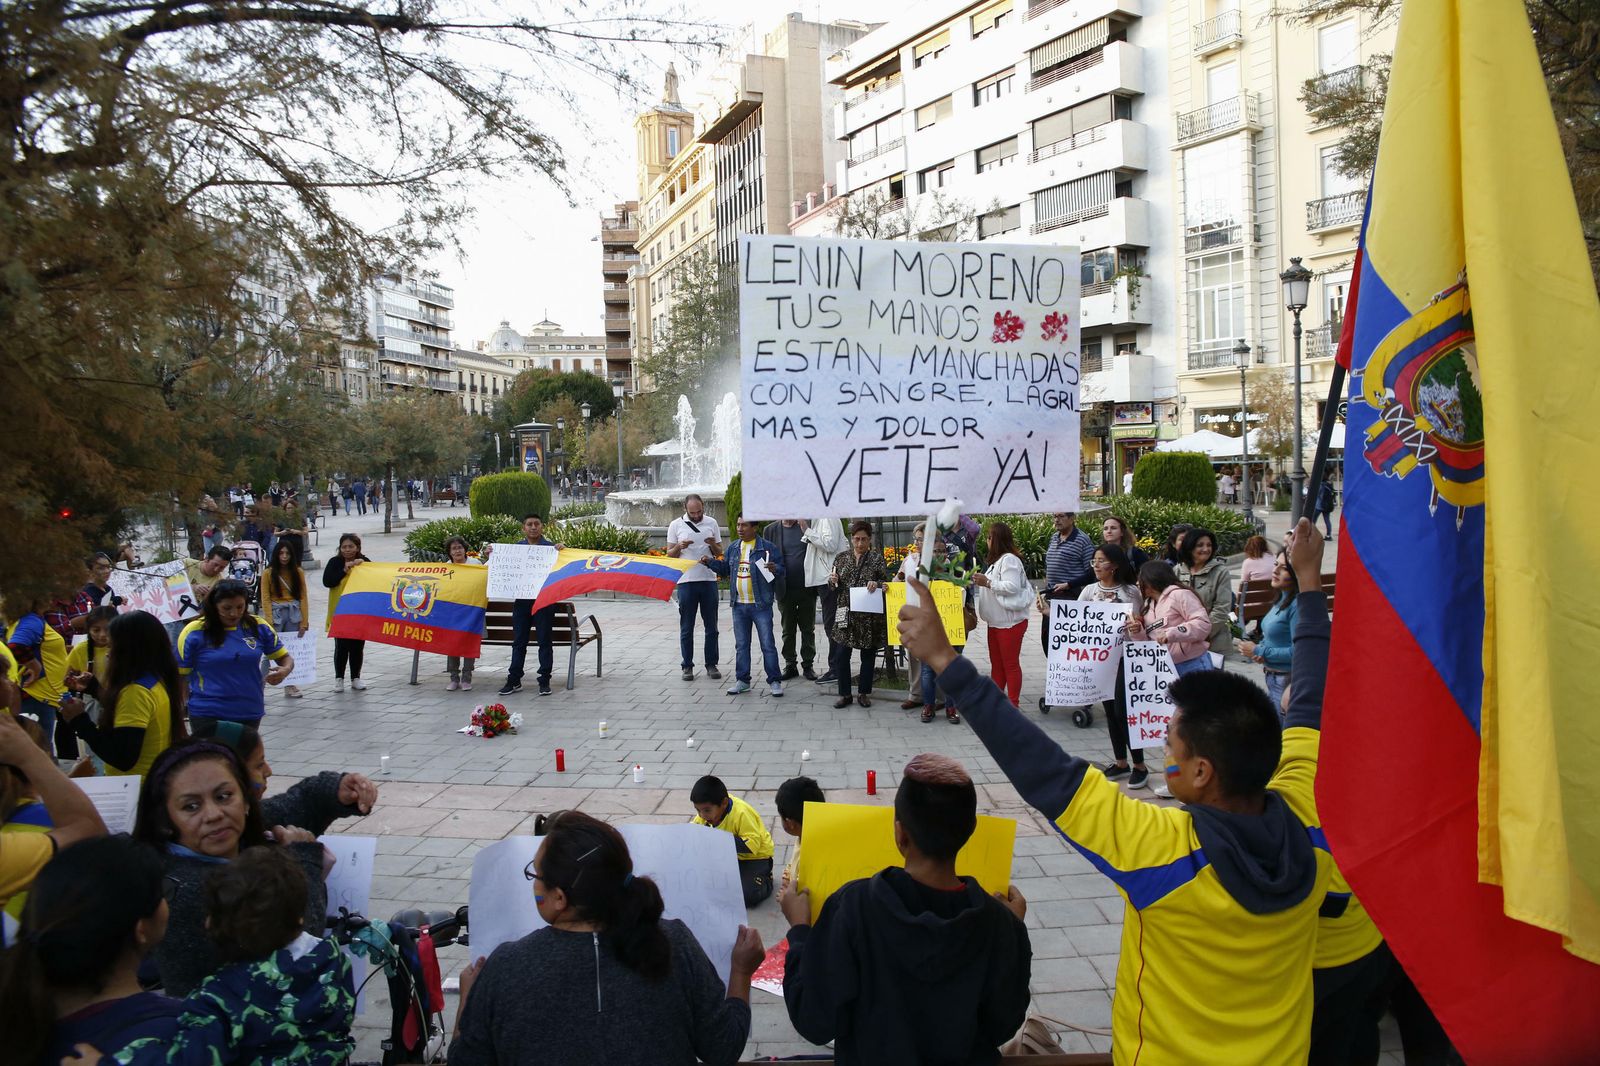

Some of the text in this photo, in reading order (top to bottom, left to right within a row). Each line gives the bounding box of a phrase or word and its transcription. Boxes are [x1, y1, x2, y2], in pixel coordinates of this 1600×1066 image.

[745, 241, 1065, 307] LENIN MORENO
[766, 293, 980, 342] TUS MANOS
[753, 337, 1080, 386] ESTAN MANCHADAS
[750, 382, 813, 406] CON
[837, 382, 993, 407] SANGRE,
[751, 415, 985, 441] MAS Y DOLOR
[1057, 604, 1128, 621] No fue un
[382, 621, 434, 643] MI PAIS
[1054, 620, 1114, 634] accidente
[1052, 632, 1110, 650] gobierno
[1067, 645, 1113, 662] MATÓ
[1131, 662, 1144, 673] la
[1128, 676, 1147, 691] de
